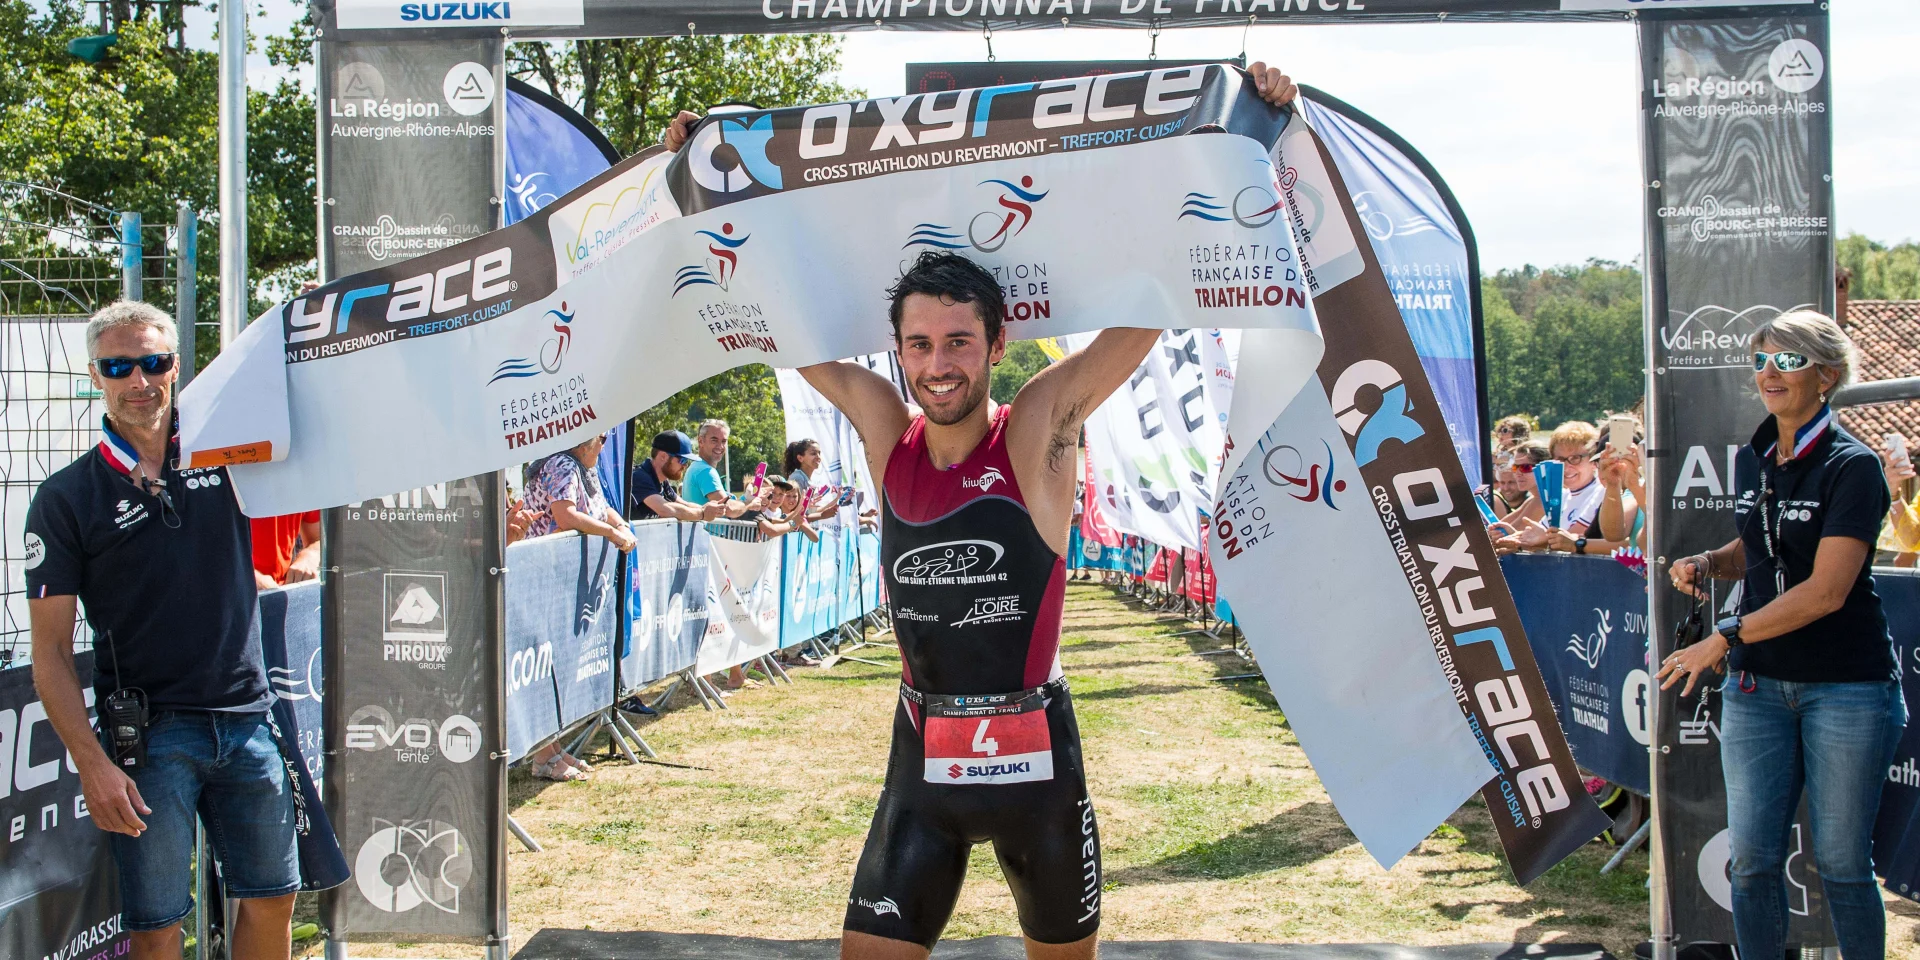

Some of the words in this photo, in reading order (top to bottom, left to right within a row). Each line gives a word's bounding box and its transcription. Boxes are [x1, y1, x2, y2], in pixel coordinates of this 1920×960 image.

[400, 2, 511, 21] SUZUKI
[1653, 78, 1680, 98] La
[1686, 75, 1764, 99] Région
[331, 99, 357, 117] La
[364, 97, 439, 121] Région
[1654, 99, 1825, 118] Auvergne-Rhône-Alpes
[331, 122, 495, 140] Auvergne-Rhône-Alpes
[804, 163, 848, 182] CROSS
[849, 153, 929, 176] TRIATHLON
[931, 150, 952, 166] DU
[955, 138, 1047, 163] REVERMONT
[1286, 189, 1306, 228] bassin
[1300, 227, 1311, 243] de
[1657, 206, 1703, 218] GRAND
[1720, 205, 1760, 216] bassin
[1763, 203, 1781, 214] de
[333, 225, 380, 236] GRAND
[398, 224, 431, 236] bassin
[434, 224, 447, 235] de
[1707, 217, 1828, 230] BOURG-EN-BRESSE
[1190, 243, 1297, 266] FÉDÉRATIO
[1192, 265, 1274, 284] FRANÇAISE
[1028, 281, 1049, 296] DE
[1195, 285, 1306, 309] TRIATHLON
[754, 320, 769, 332] DE
[300, 346, 319, 361] DU
[321, 329, 397, 357] REVERMONT
[1668, 354, 1714, 365] Treffort
[501, 373, 585, 416] FÉDÉRATION
[503, 398, 573, 431] FRANÇAISE
[577, 388, 589, 404] DE
[505, 404, 597, 450] TRIATHLON
[962, 472, 997, 489] kiwami
[114, 503, 145, 523] SUZUKI
[1372, 485, 1399, 530] CROSS
[1672, 498, 1687, 509] le
[1695, 497, 1738, 511] Dépa
[347, 510, 360, 520] le
[369, 509, 457, 523] Département
[1240, 524, 1258, 548] DE
[1391, 528, 1431, 606] TRIATHLON
[910, 576, 955, 586] SAINT-ETIENNE
[956, 573, 997, 586] TRIATHLON
[998, 572, 1008, 582] 42
[975, 599, 1019, 616] LOIRE
[1421, 605, 1438, 626] DU
[418, 662, 445, 670] GROUPE
[1428, 624, 1469, 708] REVERMONT
[1569, 675, 1608, 698] FÉDÉRATION
[1570, 692, 1602, 711] FRANÇAISE
[1602, 701, 1609, 714] DE
[1572, 707, 1608, 735] TRIATHLON
[346, 724, 431, 748] EVO
[972, 719, 998, 756] 4
[394, 748, 430, 763] Tente
[967, 762, 1030, 776] SUZUKI
[1077, 796, 1099, 923] kiwami
[858, 897, 893, 913] kiwami
